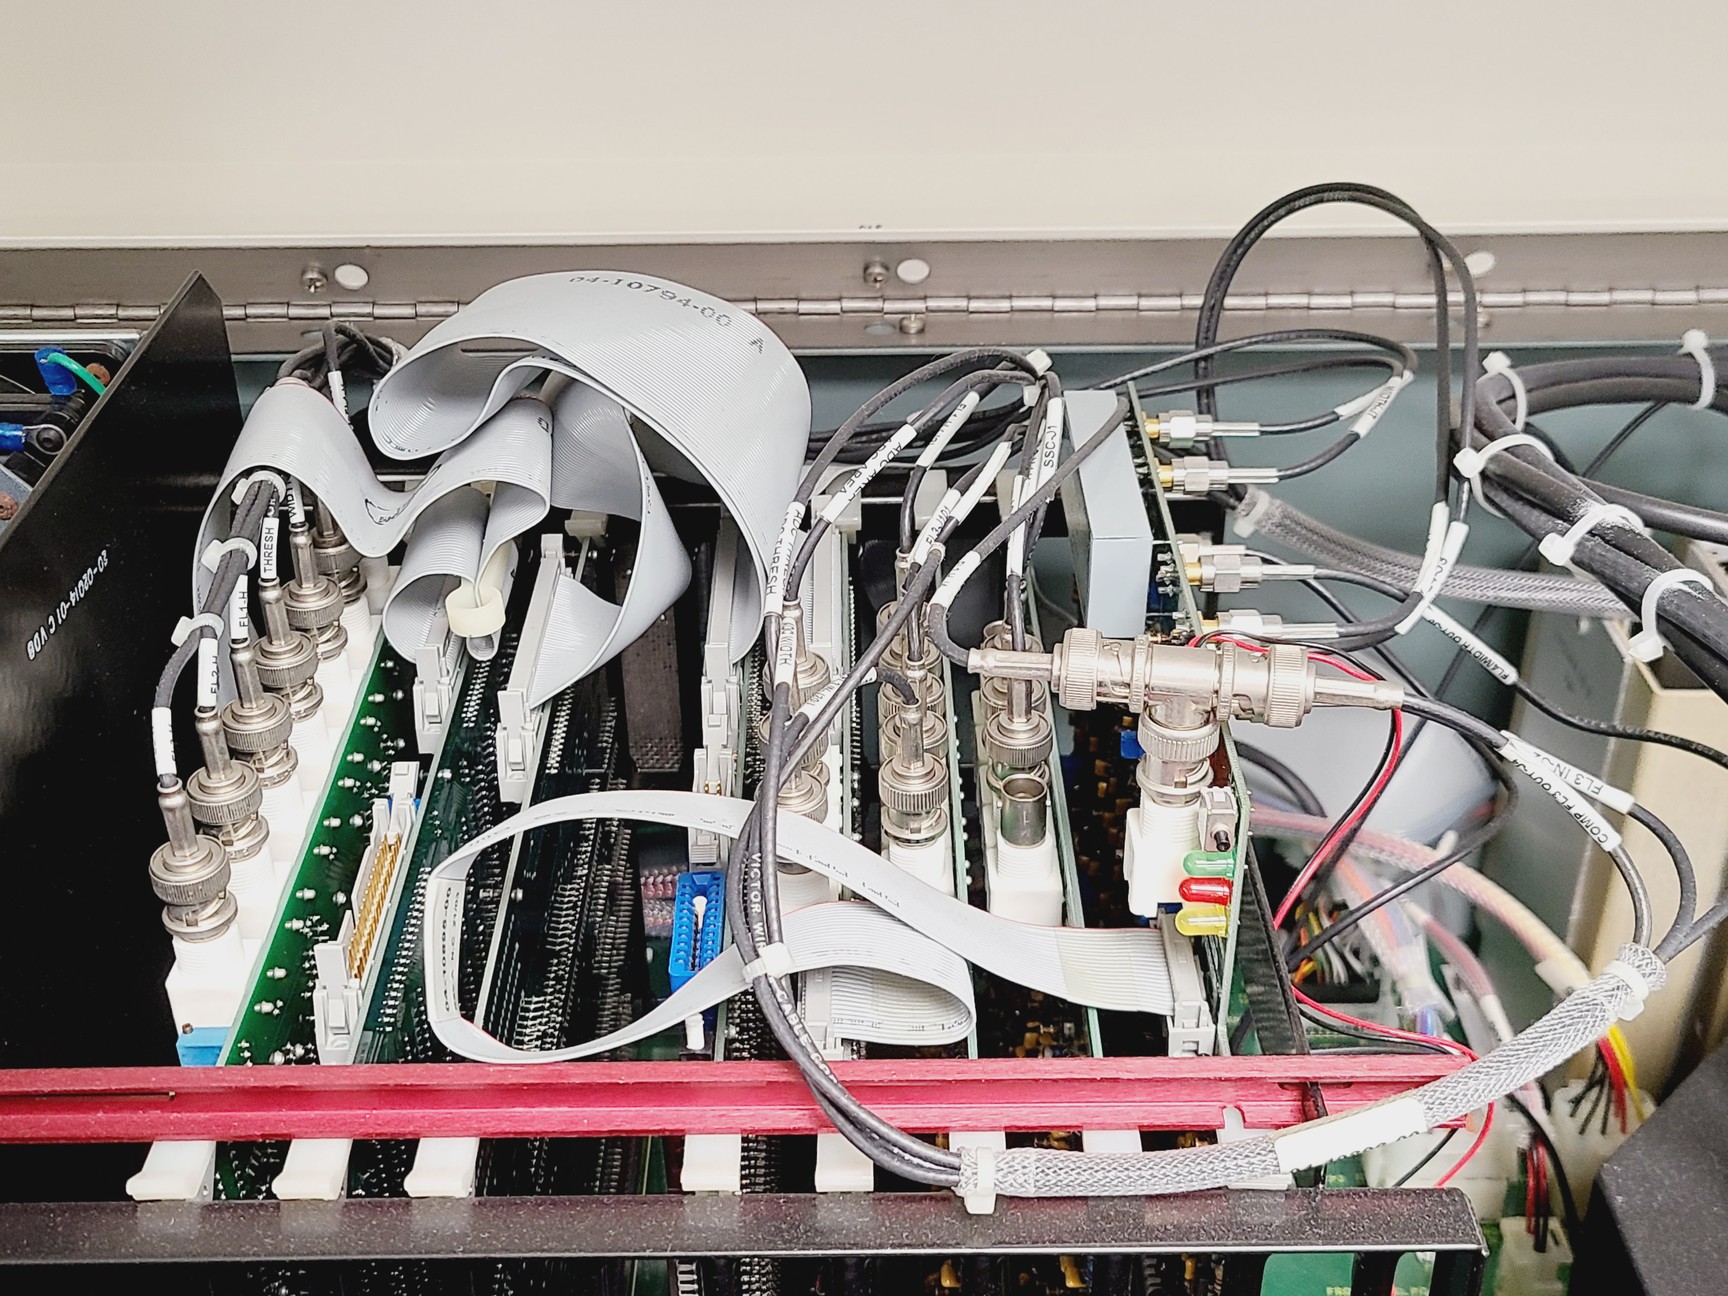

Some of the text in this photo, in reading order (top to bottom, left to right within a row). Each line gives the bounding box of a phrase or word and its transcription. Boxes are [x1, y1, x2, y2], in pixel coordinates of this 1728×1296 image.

[263, 527, 274, 574] THRESH
[1574, 812, 1608, 843] COMP
[751, 852, 762, 914] VICTOR
